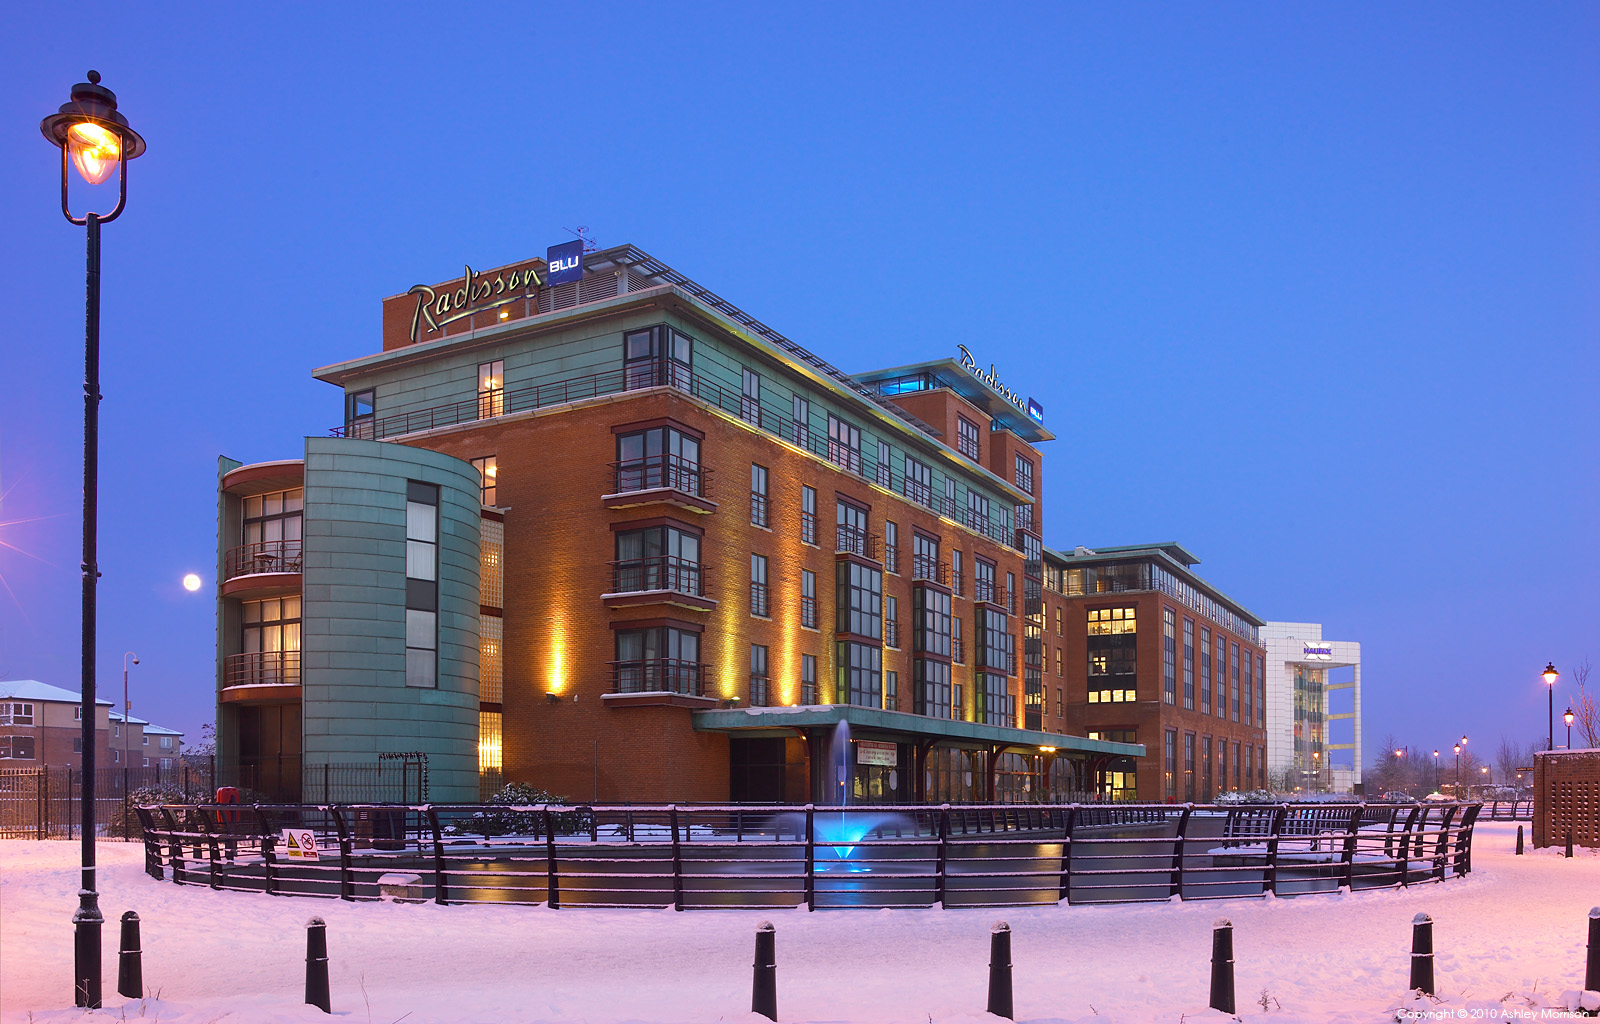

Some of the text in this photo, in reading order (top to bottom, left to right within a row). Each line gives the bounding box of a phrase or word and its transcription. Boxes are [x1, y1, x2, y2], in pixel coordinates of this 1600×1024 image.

[407, 255, 579, 342] Radisson BLU
[957, 344, 1043, 421] Radisson BLU
[1303, 647, 1332, 655] HALIFAX
